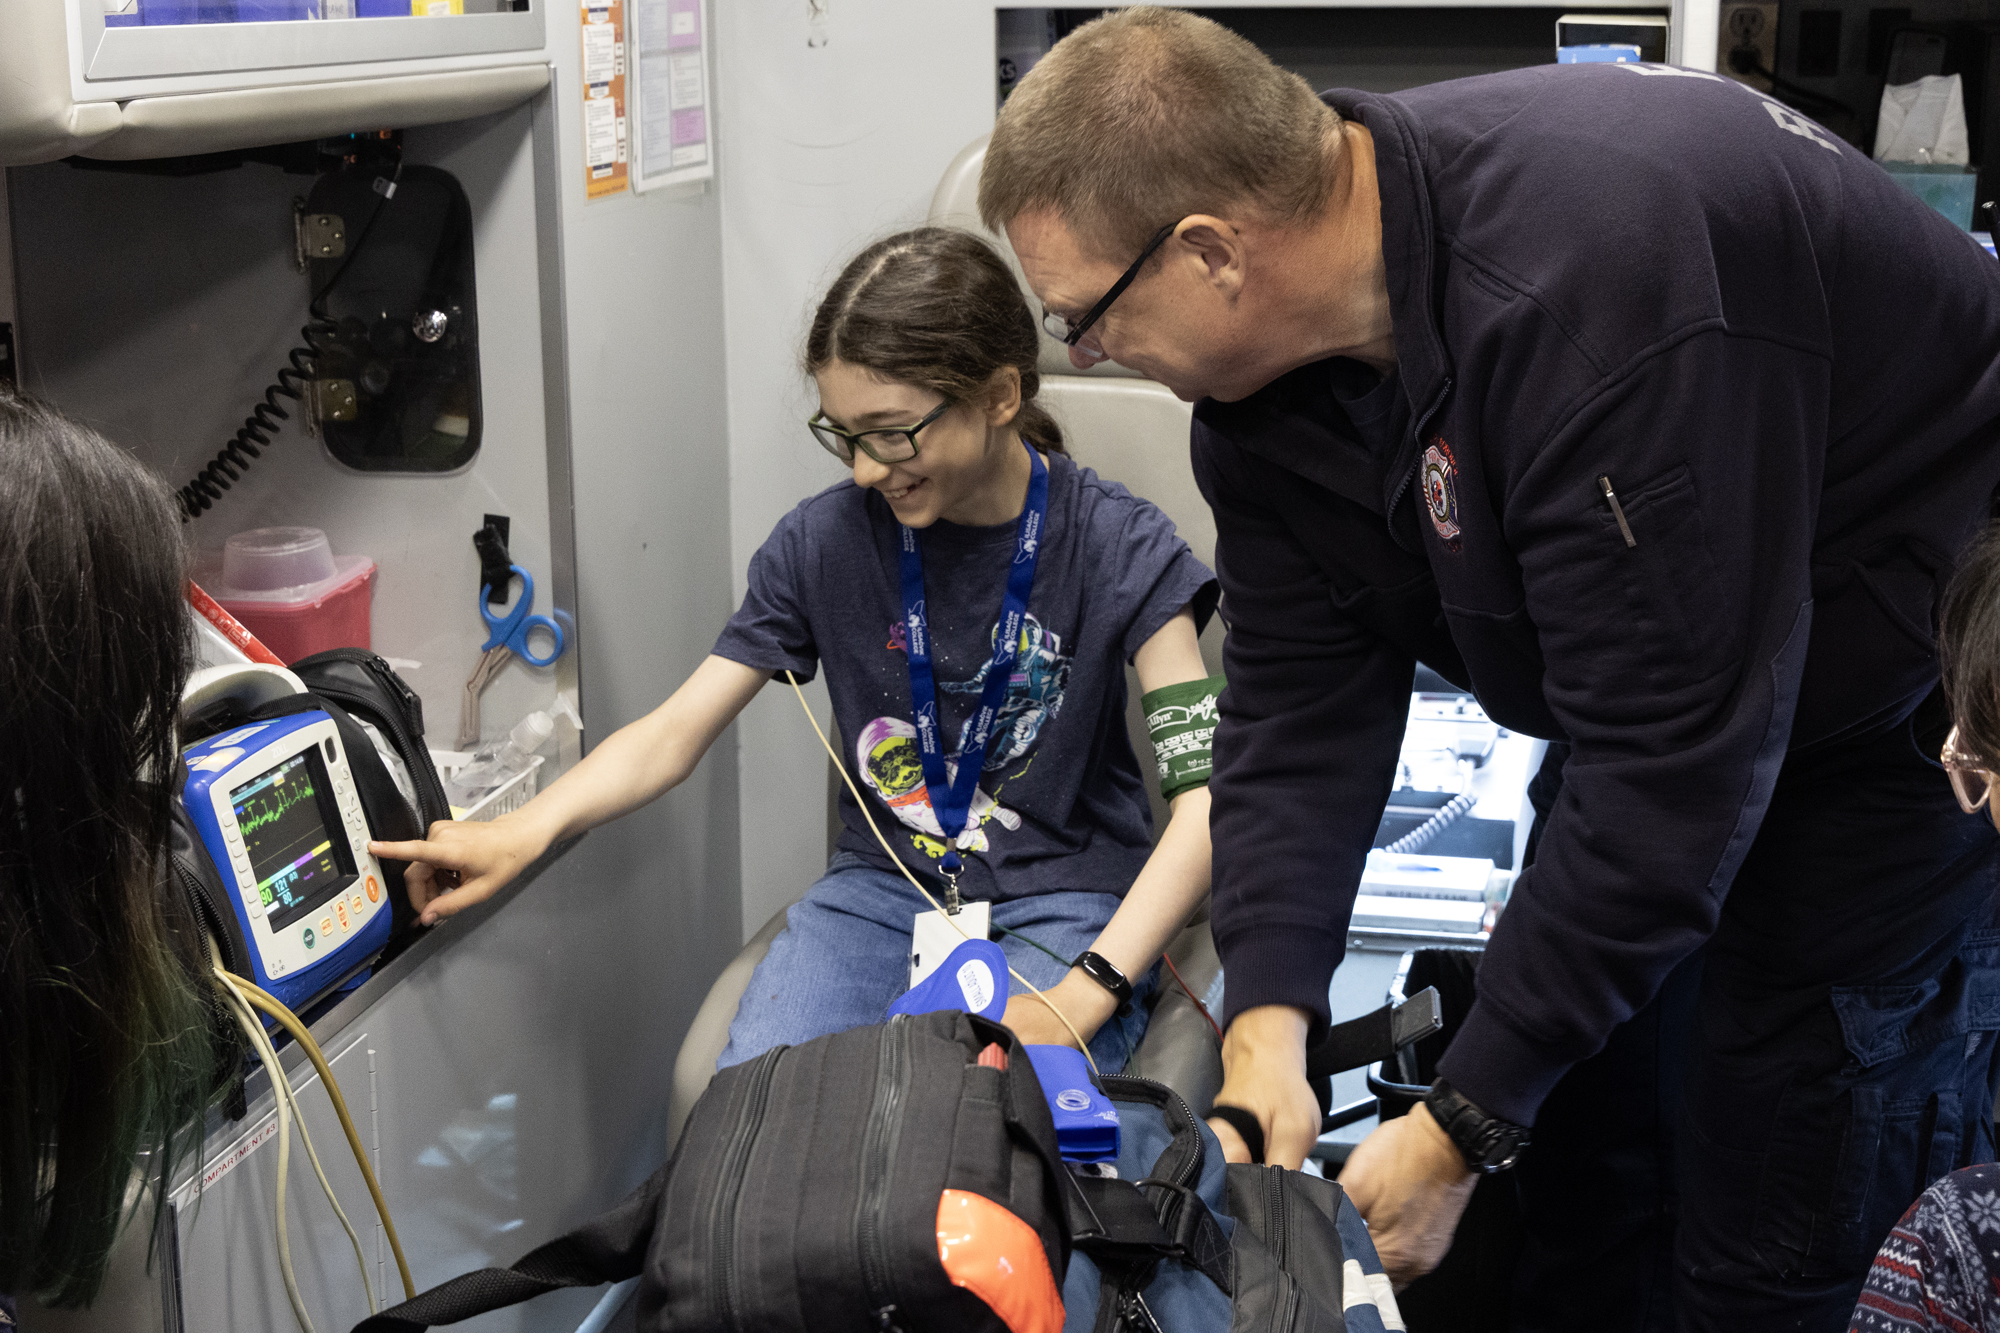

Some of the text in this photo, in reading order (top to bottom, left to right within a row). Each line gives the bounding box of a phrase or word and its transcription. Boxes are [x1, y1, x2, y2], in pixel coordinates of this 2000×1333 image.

[1030, 512, 1040, 540] COLLEGE
[1010, 613, 1020, 640] COLLEGE
[911, 627, 919, 654] COLLEGE
[982, 708, 994, 733] COLLEGE
[273, 745, 287, 758] ZOLL
[921, 727, 930, 753] COLLEGE
[261, 888, 273, 906] 90
[275, 877, 288, 892] 121
[282, 891, 293, 905] 80
[971, 985, 987, 1007] SMALL
[193, 1124, 276, 1193] COMPARTMENT #3
